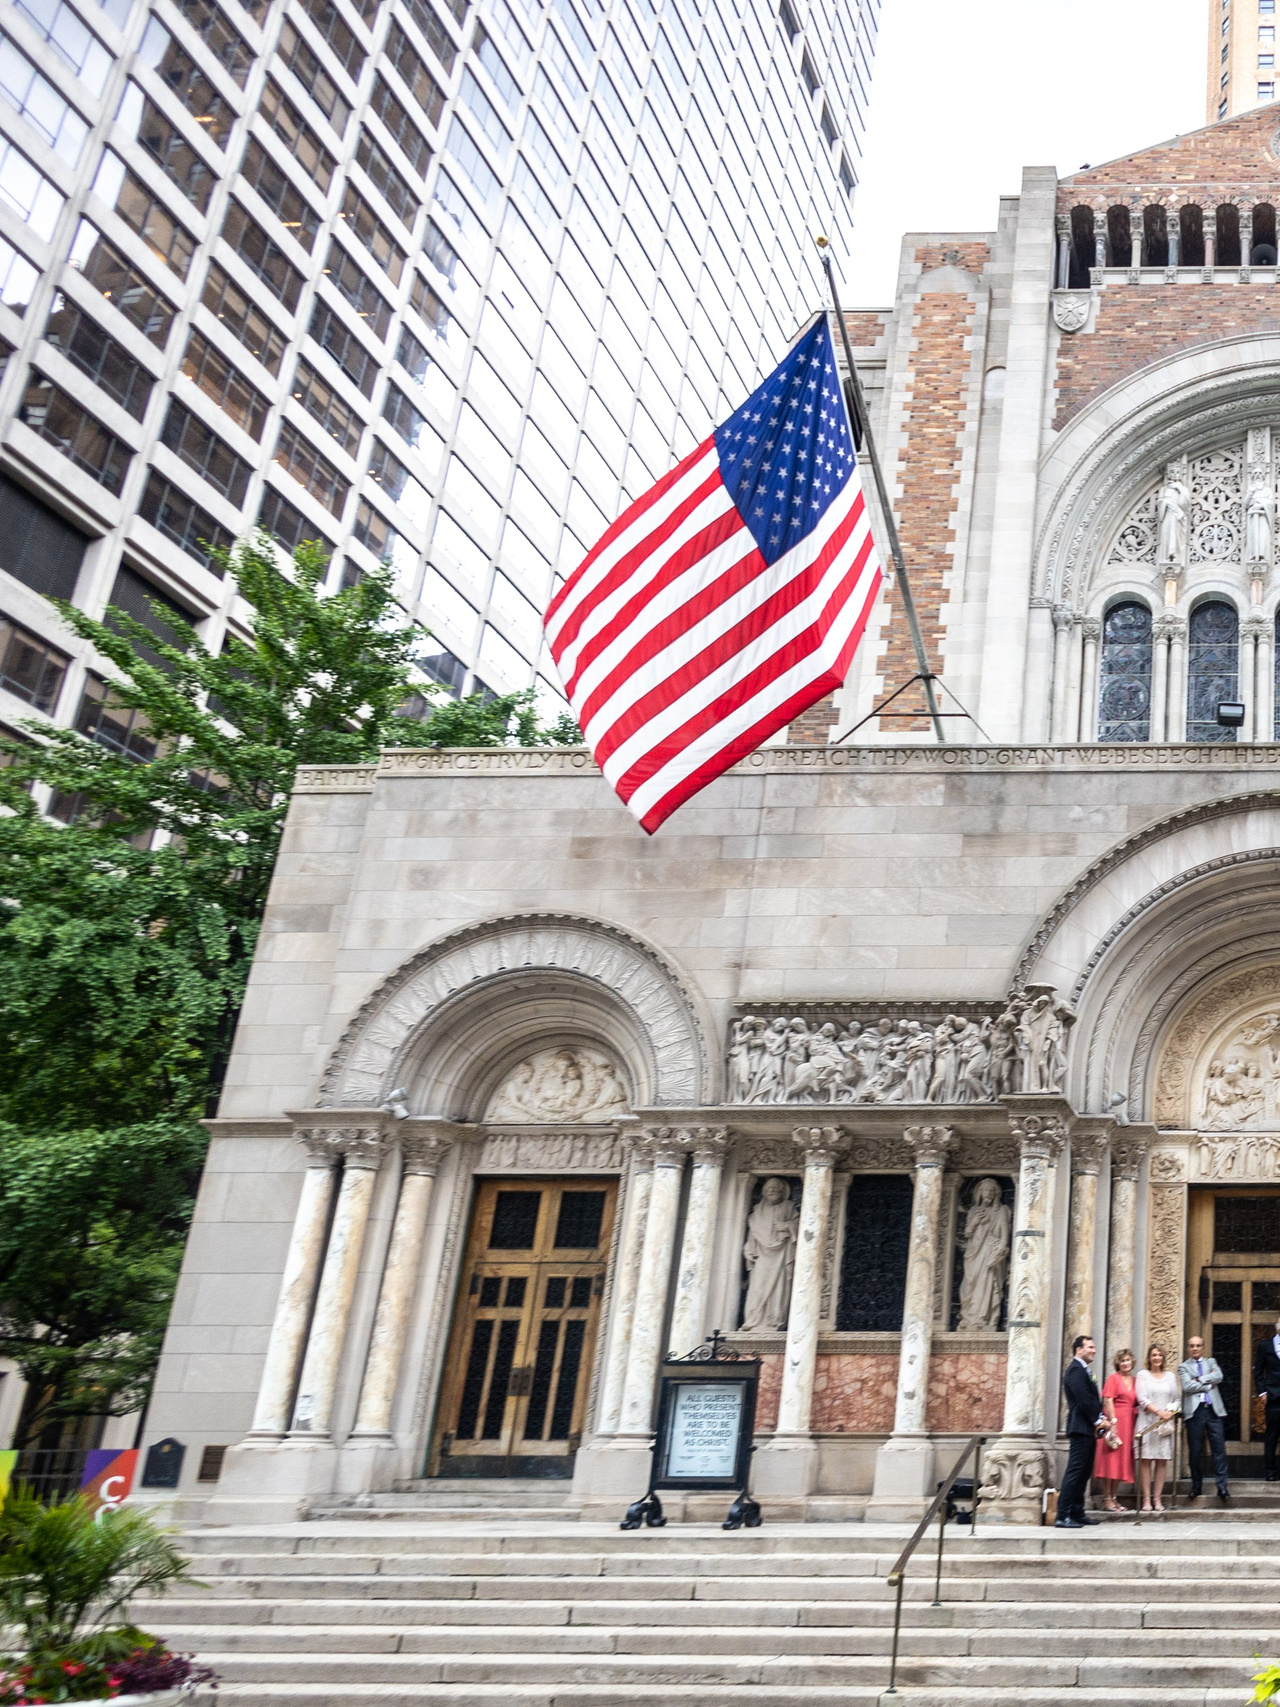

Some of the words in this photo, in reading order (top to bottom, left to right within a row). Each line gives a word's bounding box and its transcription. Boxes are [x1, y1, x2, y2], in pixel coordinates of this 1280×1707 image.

[415, 753, 478, 769] GRACE
[483, 752, 551, 769] TRVLY
[557, 752, 587, 768] TO
[772, 750, 860, 766] PREACH
[868, 750, 915, 766] THY
[920, 750, 990, 765] WORD
[996, 749, 1071, 765] GRANT
[1077, 749, 1110, 764] WE
[1114, 748, 1212, 764] BESEECH
[1218, 748, 1278, 764] THEE
[685, 1394, 702, 1403] ALL
[703, 1394, 737, 1402] GUESTS
[679, 1403, 702, 1411] WHO
[703, 1403, 741, 1411] PRESENT
[682, 1412, 737, 1420] THEMSELVES
[686, 1421, 704, 1429] ARE
[718, 1420, 731, 1428] BE
[682, 1429, 733, 1437] WELCOMED
[683, 1438, 696, 1447] AS
